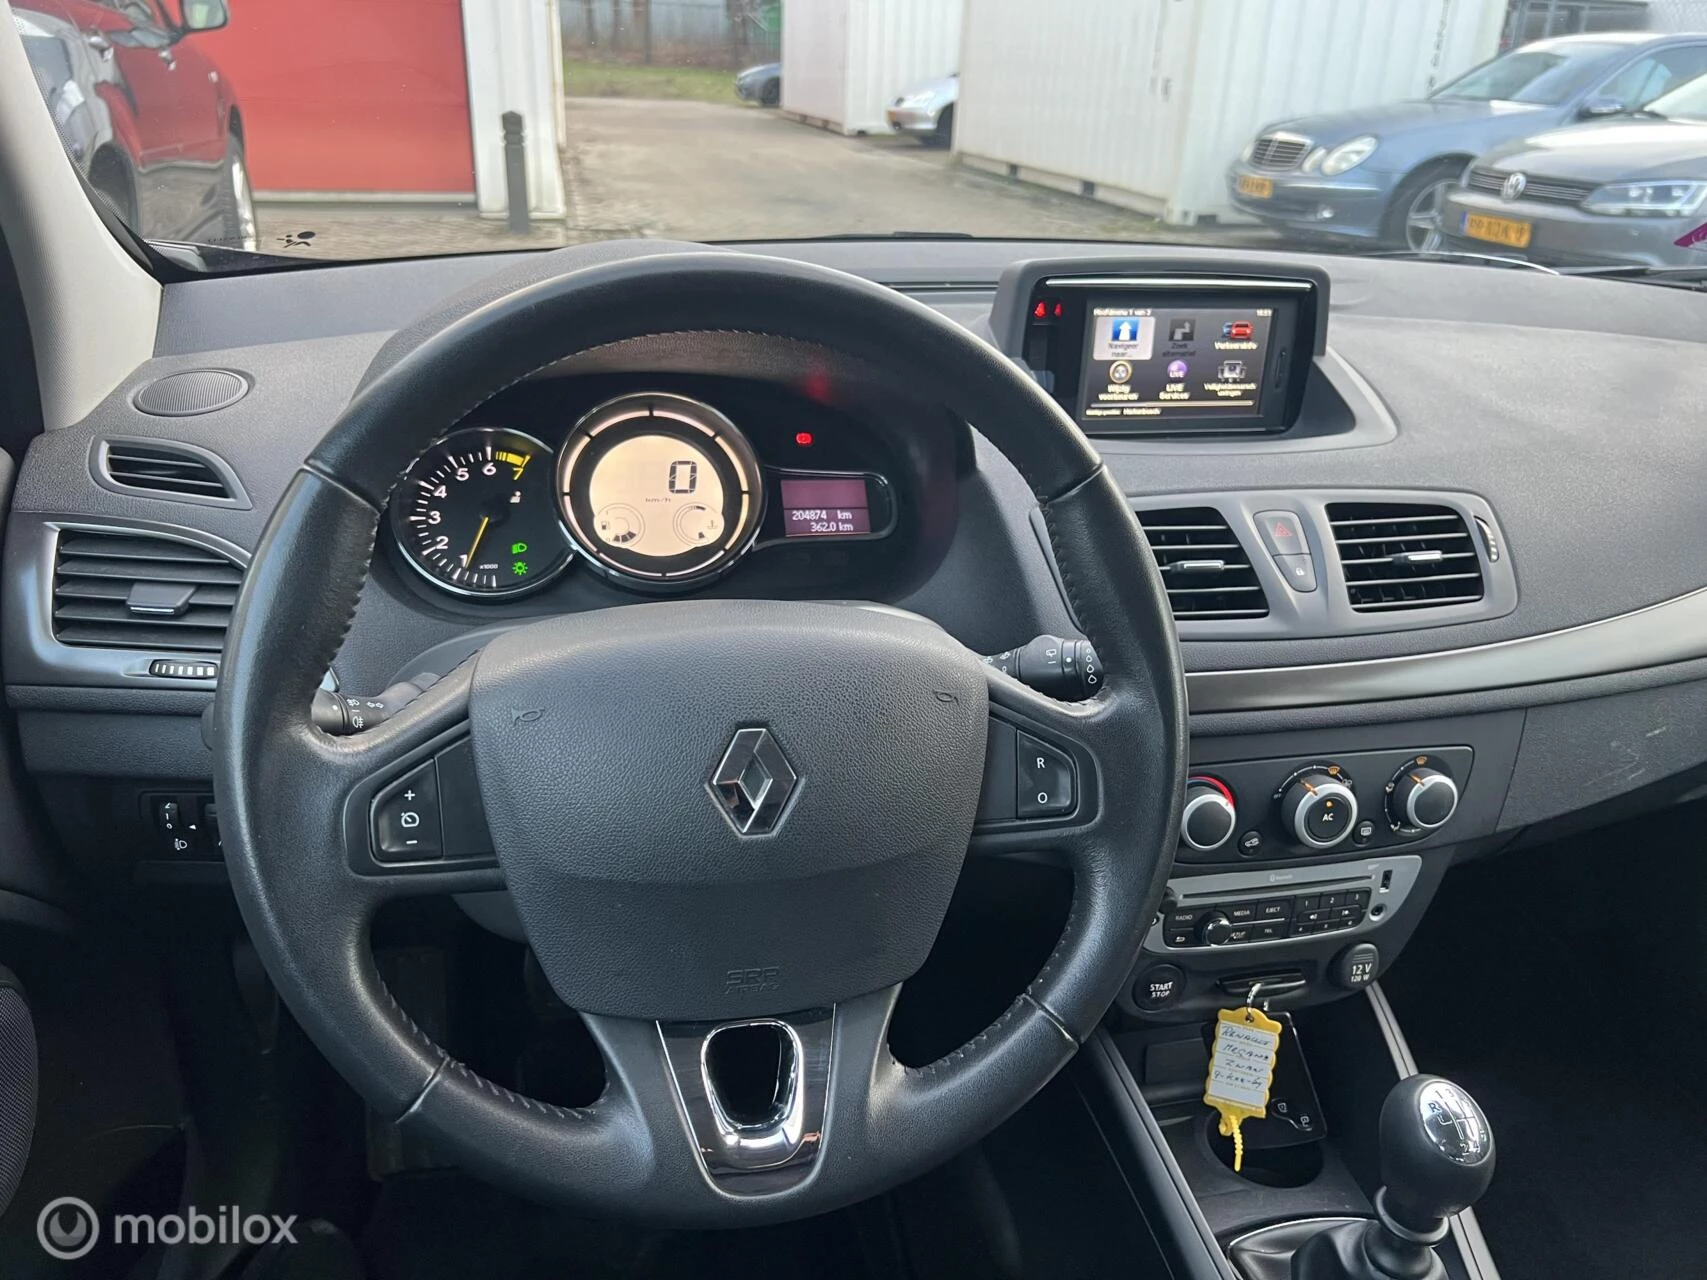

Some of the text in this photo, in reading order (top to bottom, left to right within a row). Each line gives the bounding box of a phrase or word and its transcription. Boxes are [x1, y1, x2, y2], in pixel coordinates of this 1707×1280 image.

[455, 468, 470, 482] 5
[482, 462, 497, 476] 6
[513, 467, 524, 481] 7
[668, 460, 698, 495] 0
[433, 485, 448, 499] 4
[427, 510, 442, 525] 3
[791, 509, 853, 521] 204874 km
[809, 521, 854, 533] 362.0 km
[435, 535, 449, 550] 2
[1036, 756, 1046, 769] R
[1322, 812, 1335, 822] AC
[1233, 909, 1251, 917] MEDIA
[1265, 906, 1281, 914] EJECT
[1351, 962, 1372, 975] 12 V
[1149, 981, 1173, 992] START
[1151, 990, 1170, 998] STOP
[1428, 1101, 1441, 1114] R
